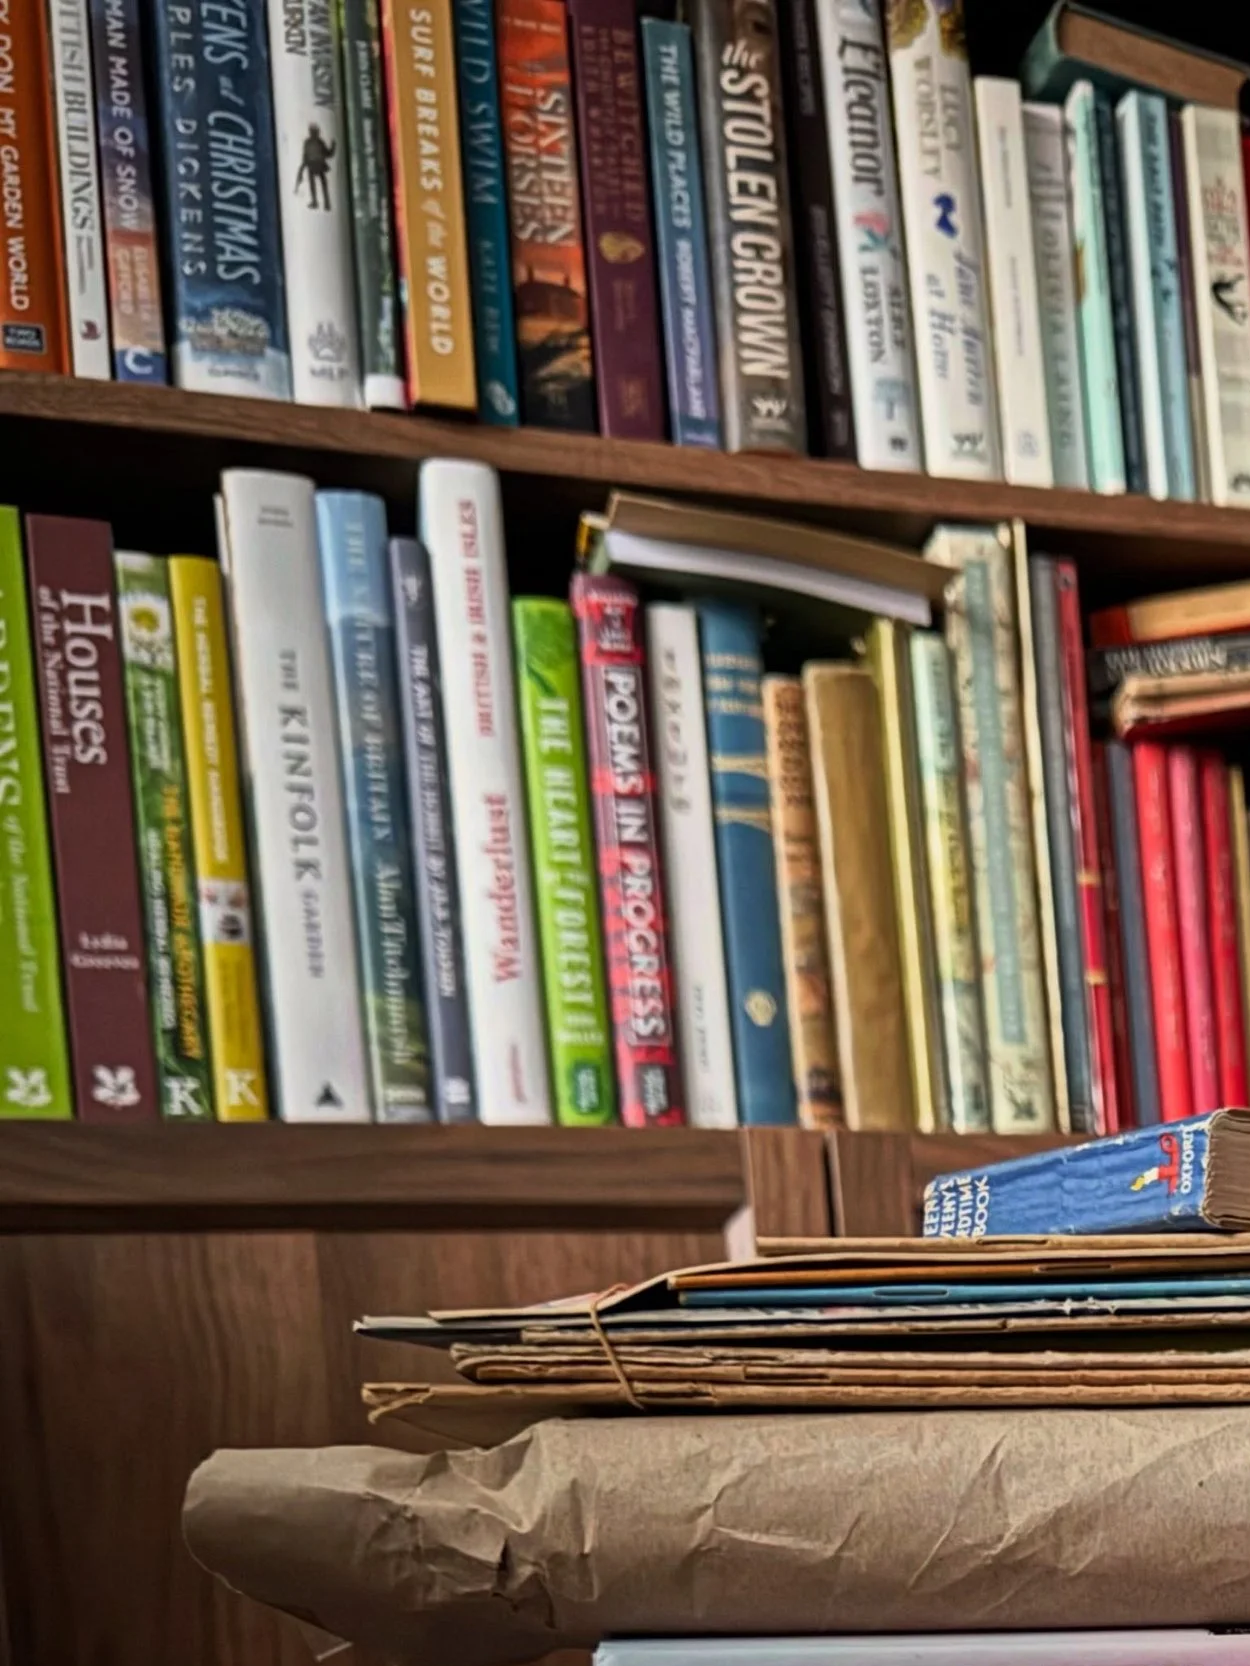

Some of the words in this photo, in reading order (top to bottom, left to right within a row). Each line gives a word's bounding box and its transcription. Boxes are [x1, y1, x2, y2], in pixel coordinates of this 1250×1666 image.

[108, 55, 134, 120] MADE
[409, 9, 437, 77] SURF
[659, 42, 681, 86] THE
[720, 39, 760, 69] the
[63, 89, 95, 232] BUILDINGS
[113, 125, 136, 159] OF
[414, 87, 444, 192] BREAKS
[467, 103, 499, 205] SWIM
[537, 90, 577, 246] SIXTEEN
[663, 91, 686, 147] WILD
[719, 70, 778, 226] STOLEN
[837, 36, 885, 198] Eleanor
[913, 56, 942, 178] WORSLEY
[0, 144, 23, 230] GARDEN
[115, 163, 142, 230] SNOW
[174, 117, 207, 277] DICKENS
[207, 110, 262, 286] CHRISTMAS
[667, 150, 692, 230] PLACES
[7, 235, 30, 312] WORLD
[426, 251, 454, 355] WORLD
[731, 228, 792, 380] CROWN
[859, 264, 887, 365] LOXTON
[43, 649, 70, 737] National
[60, 588, 113, 768] Houses
[536, 698, 570, 754] THE
[603, 669, 642, 794] POEMS
[278, 707, 323, 881] KINFOLK
[540, 766, 582, 868] HEART
[615, 802, 647, 847] IN
[484, 792, 523, 985] Wanderlust
[552, 887, 594, 1009] FOREST
[619, 850, 669, 1044] PROGRESS
[956, 1175, 974, 1237] EDTIME
[971, 1174, 990, 1238] BOOK
[1180, 1124, 1195, 1194] OXFORD
